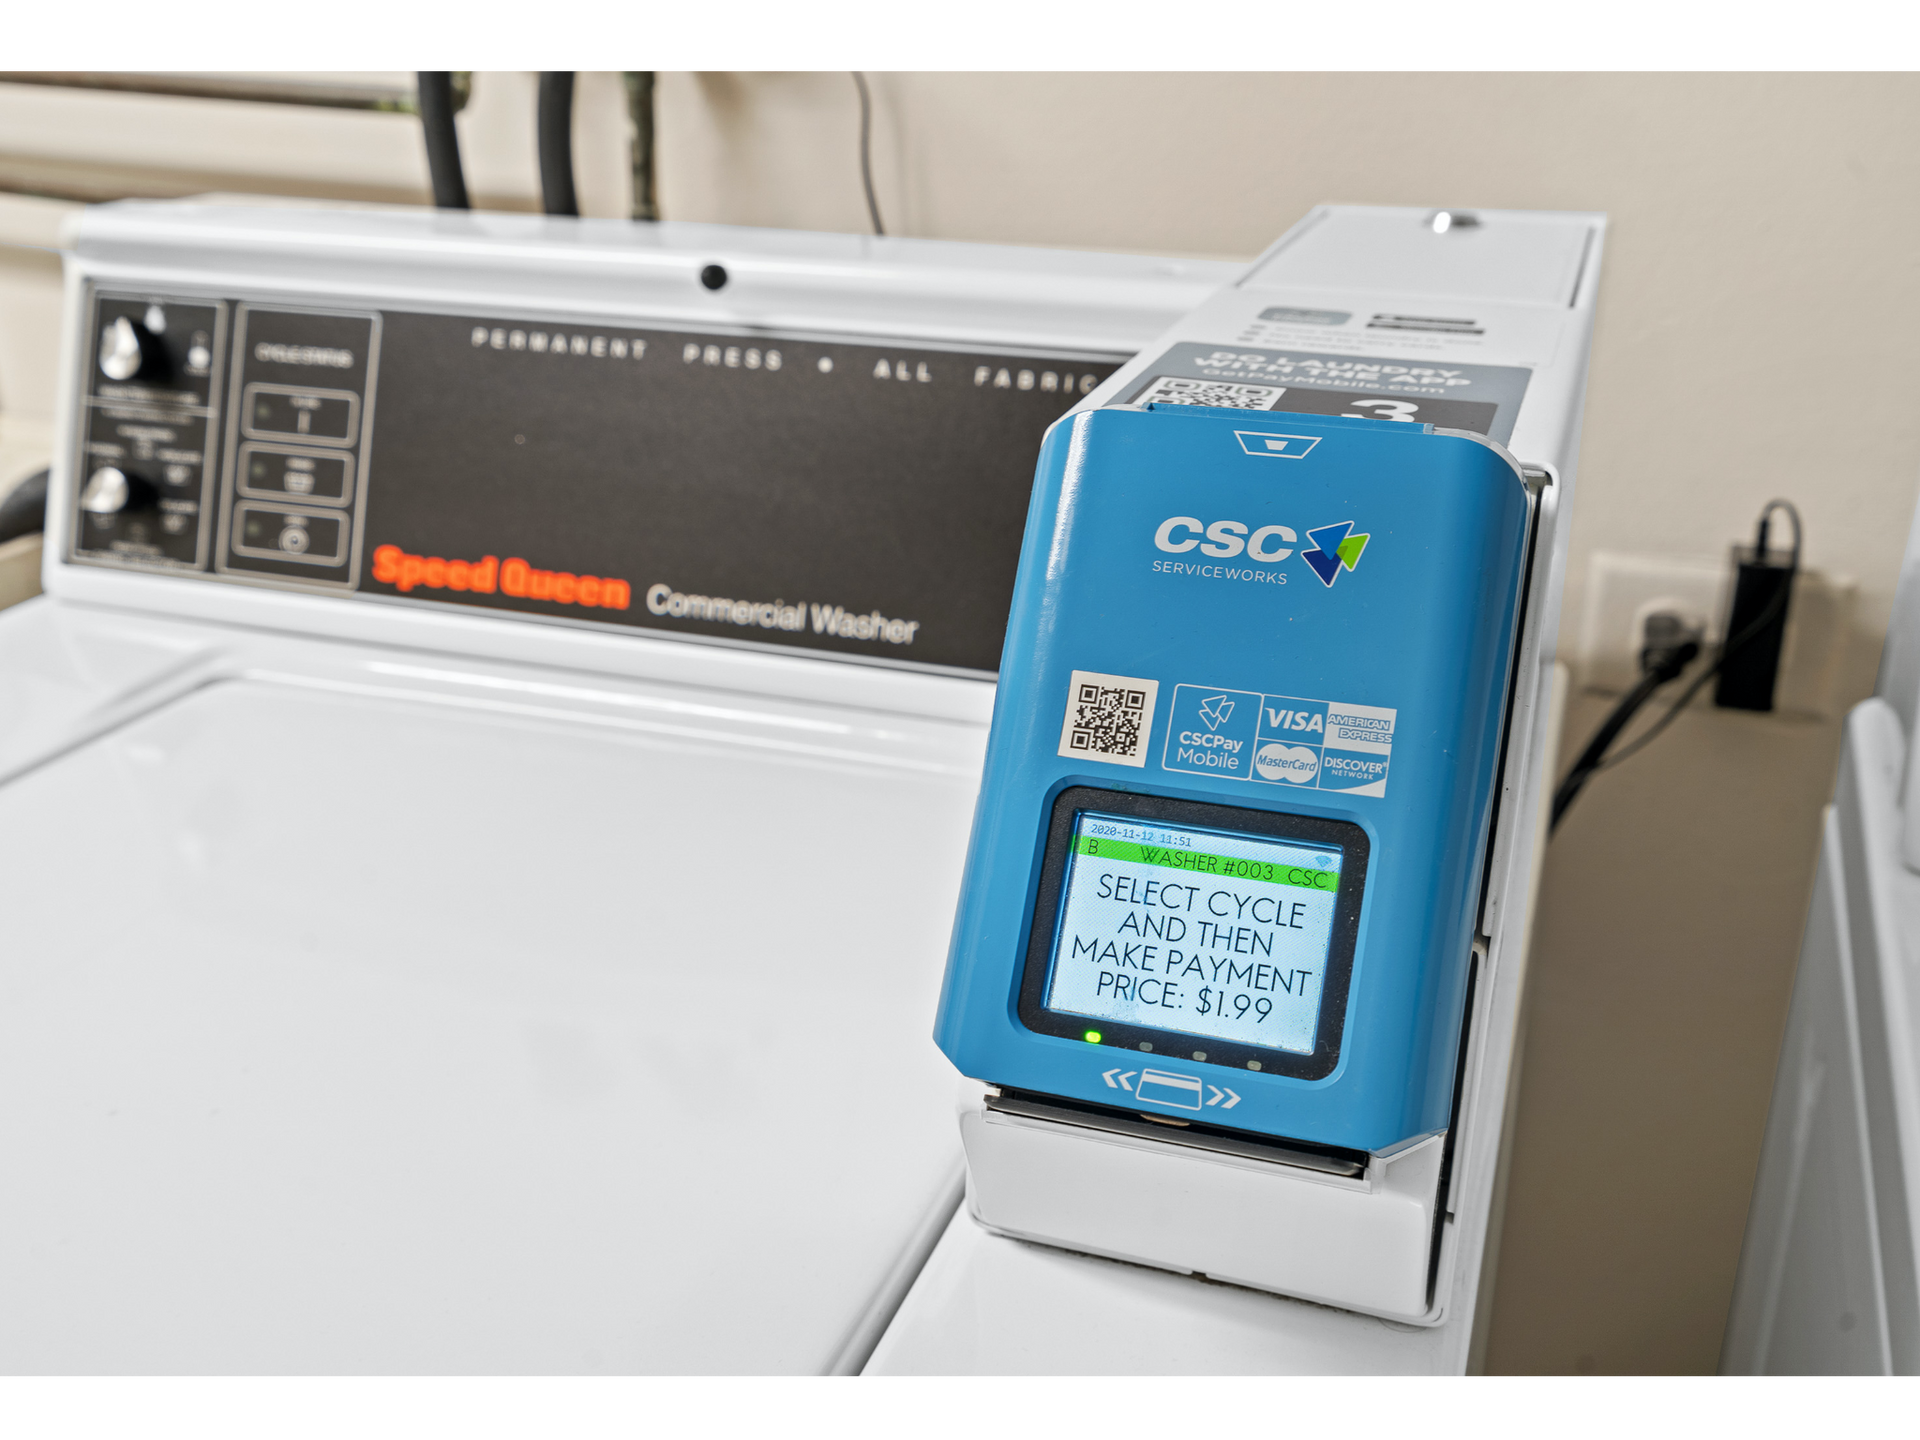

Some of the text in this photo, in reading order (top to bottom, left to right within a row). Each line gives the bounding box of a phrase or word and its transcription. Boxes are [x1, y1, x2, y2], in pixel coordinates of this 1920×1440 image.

[472, 327, 648, 360] PERMANENT
[682, 342, 784, 371] PRESS
[873, 358, 933, 384] ALL
[1209, 351, 1462, 378] DO LAUNDRY
[1194, 356, 1472, 387] WITH THE APP
[1202, 367, 1446, 395] GetPayMobile.com
[1154, 516, 1297, 562] CSC
[1152, 560, 1288, 585] SERVICEWORKS
[372, 544, 919, 645] Speed Queen Commercial Washer
[1265, 707, 1324, 733] VISA
[1327, 713, 1391, 732] AMERICAN
[1179, 731, 1244, 753] CSCPay
[1338, 727, 1393, 745] EXPRESS
[1177, 747, 1239, 770] Mobile
[1257, 754, 1317, 773] MasterCard
[1331, 769, 1375, 780] NETWORK
[1090, 823, 1192, 848] 2020-11-12 11:51
[1087, 839, 1329, 889] B WASHER #003 CSC
[1096, 873, 1307, 930] SELECT CYCLE
[1117, 911, 1274, 958] AND THEN
[1071, 934, 1313, 997] MAKE PAYMENT
[1096, 971, 1274, 1024] PRICE: $1.99
